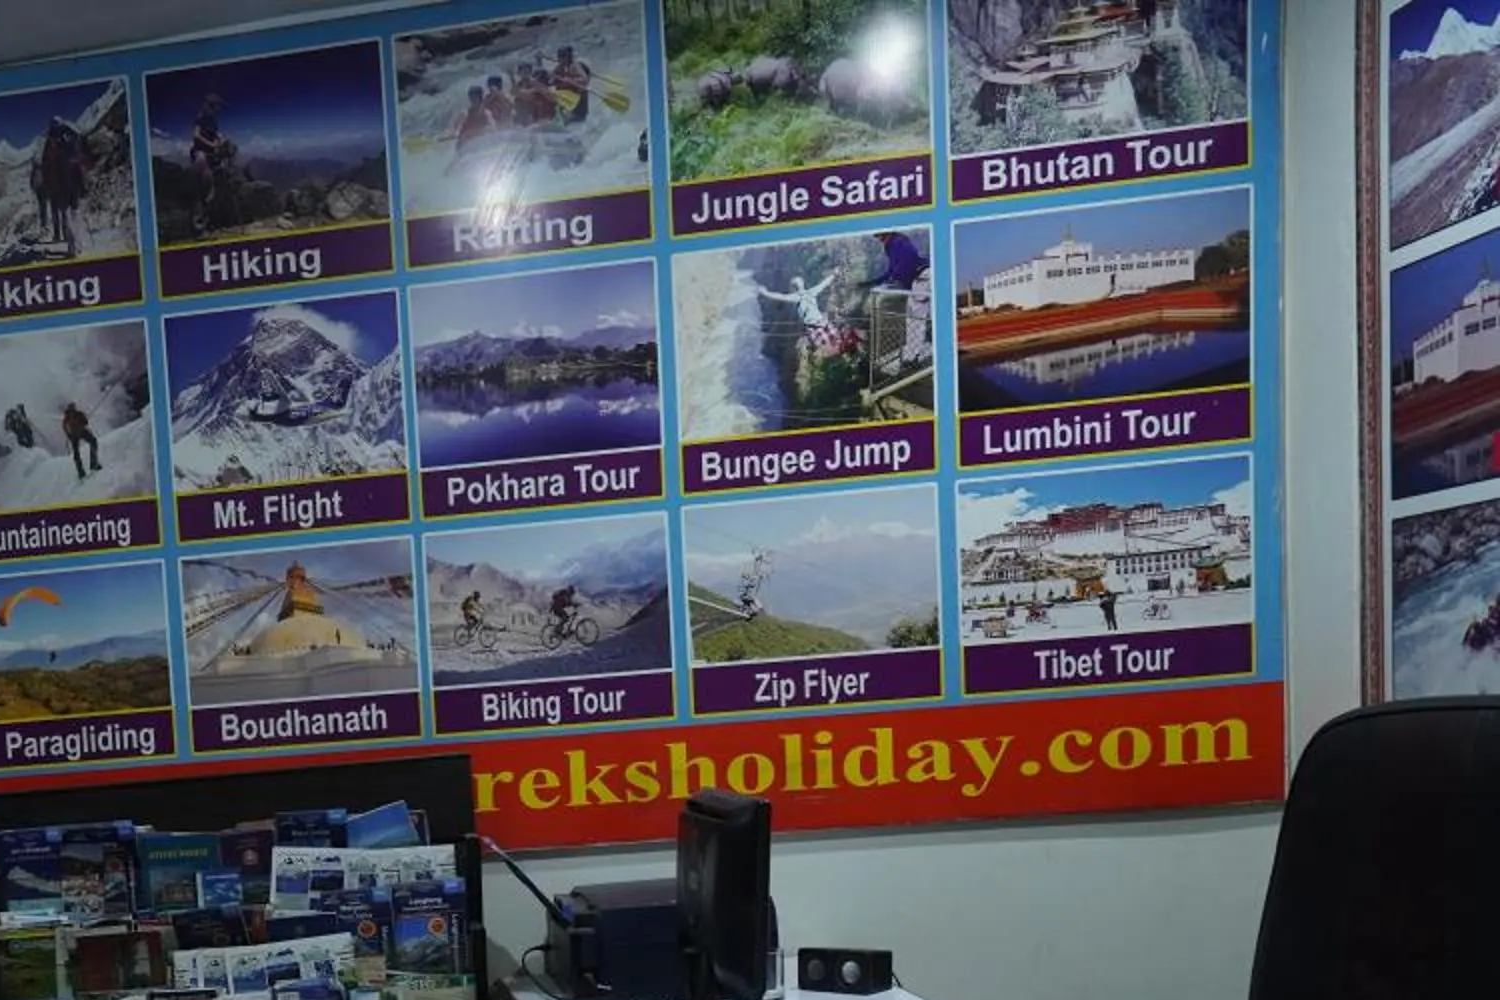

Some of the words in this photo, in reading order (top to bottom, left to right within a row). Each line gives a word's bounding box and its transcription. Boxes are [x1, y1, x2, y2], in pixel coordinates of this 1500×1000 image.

[982, 151, 1114, 191] Bhutan
[1124, 138, 1213, 176] Tour
[691, 180, 810, 225] Jungle
[821, 166, 924, 205] Safari
[452, 213, 594, 252] Rafting
[202, 243, 323, 284] Hiking
[983, 412, 1112, 455] Lumbini
[1121, 405, 1197, 442] Tour
[700, 449, 816, 485] Bungee
[825, 438, 912, 475] Jump
[446, 474, 566, 506] Pokhara
[573, 463, 641, 496] Tour
[213, 500, 257, 530] Mt.
[263, 490, 344, 527] Flight
[1033, 646, 1104, 681] Tibet
[1109, 643, 1176, 677] Tour
[481, 691, 562, 724] Biking
[567, 686, 626, 717] Tour
[754, 672, 797, 708] Zip
[803, 667, 871, 703] Flyer
[5, 723, 156, 762] Paragliding
[220, 702, 388, 744] Boudhanath
